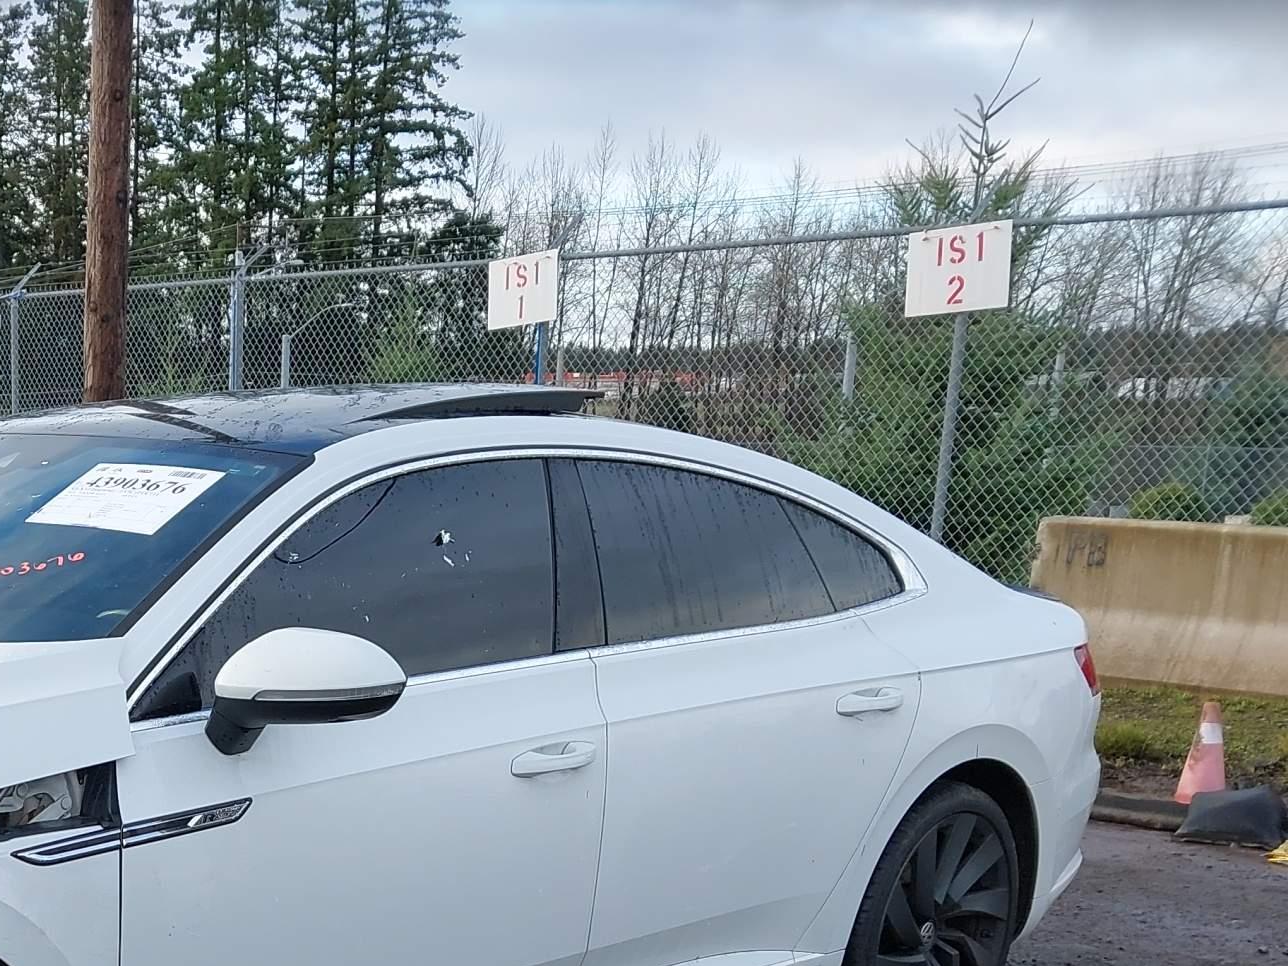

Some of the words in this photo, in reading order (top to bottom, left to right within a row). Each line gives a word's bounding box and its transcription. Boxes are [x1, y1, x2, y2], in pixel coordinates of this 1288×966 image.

[946, 275, 966, 305] 2
[517, 294, 524, 319] 1
[86, 475, 193, 495] 43903676
